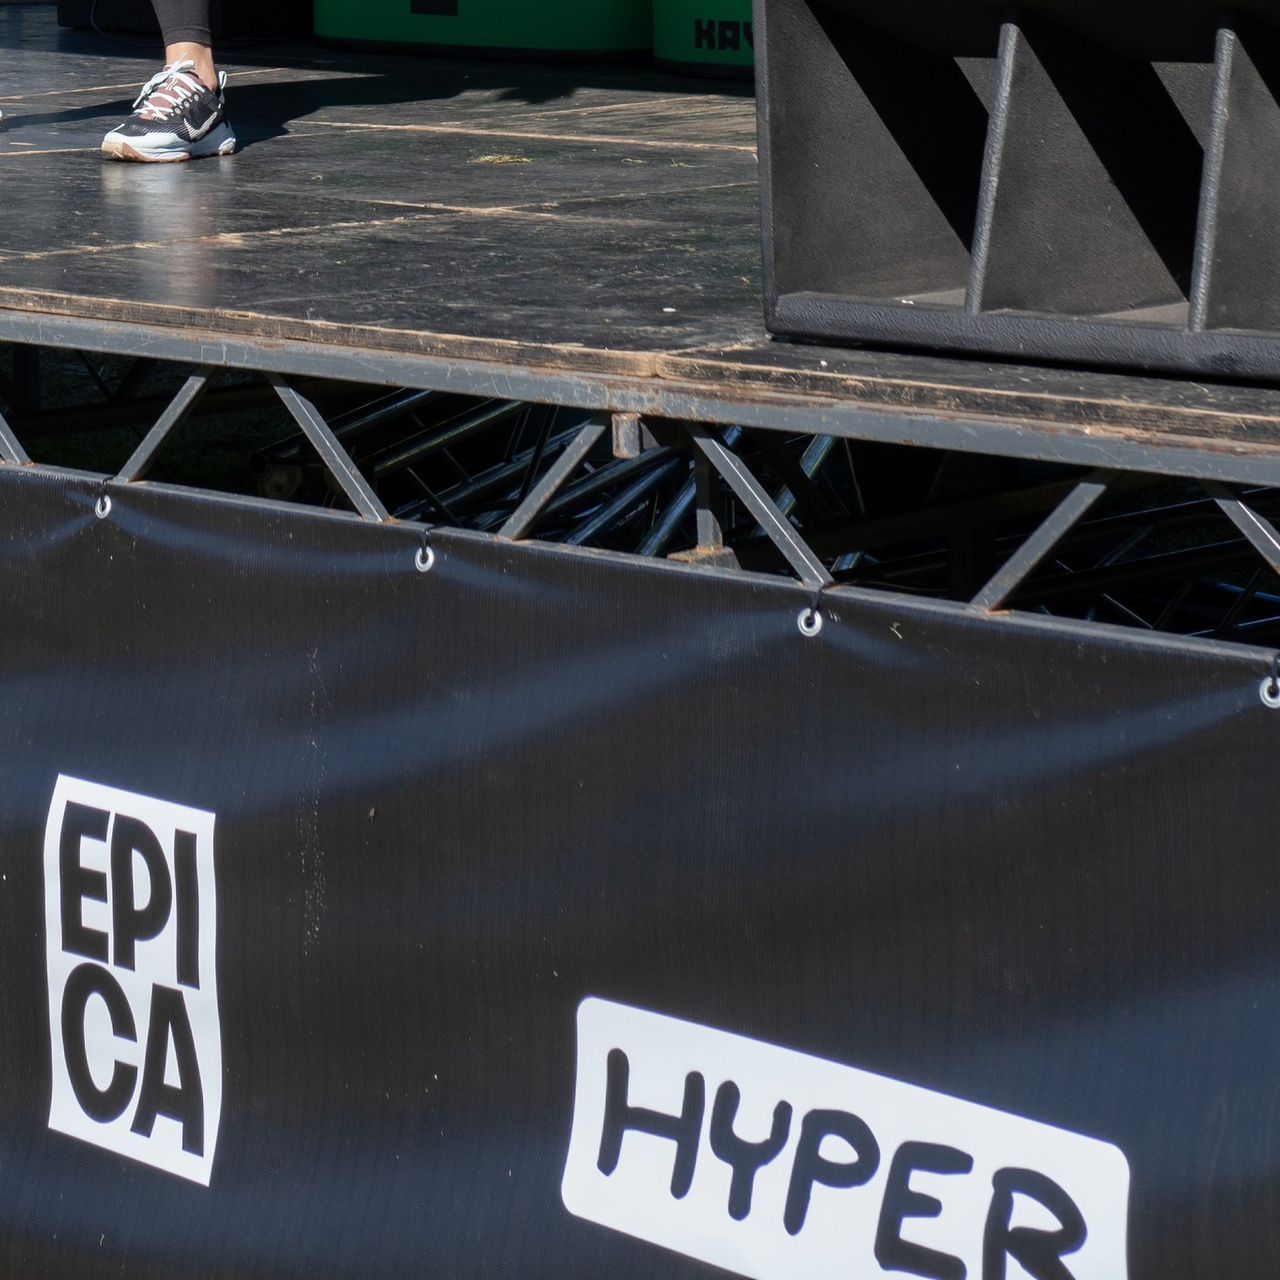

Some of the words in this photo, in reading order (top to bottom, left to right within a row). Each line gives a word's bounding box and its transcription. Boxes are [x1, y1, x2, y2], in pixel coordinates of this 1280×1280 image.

[59, 800, 201, 990] EPI
[61, 962, 205, 1158] CA
[596, 1047, 1089, 1280] HYPER
